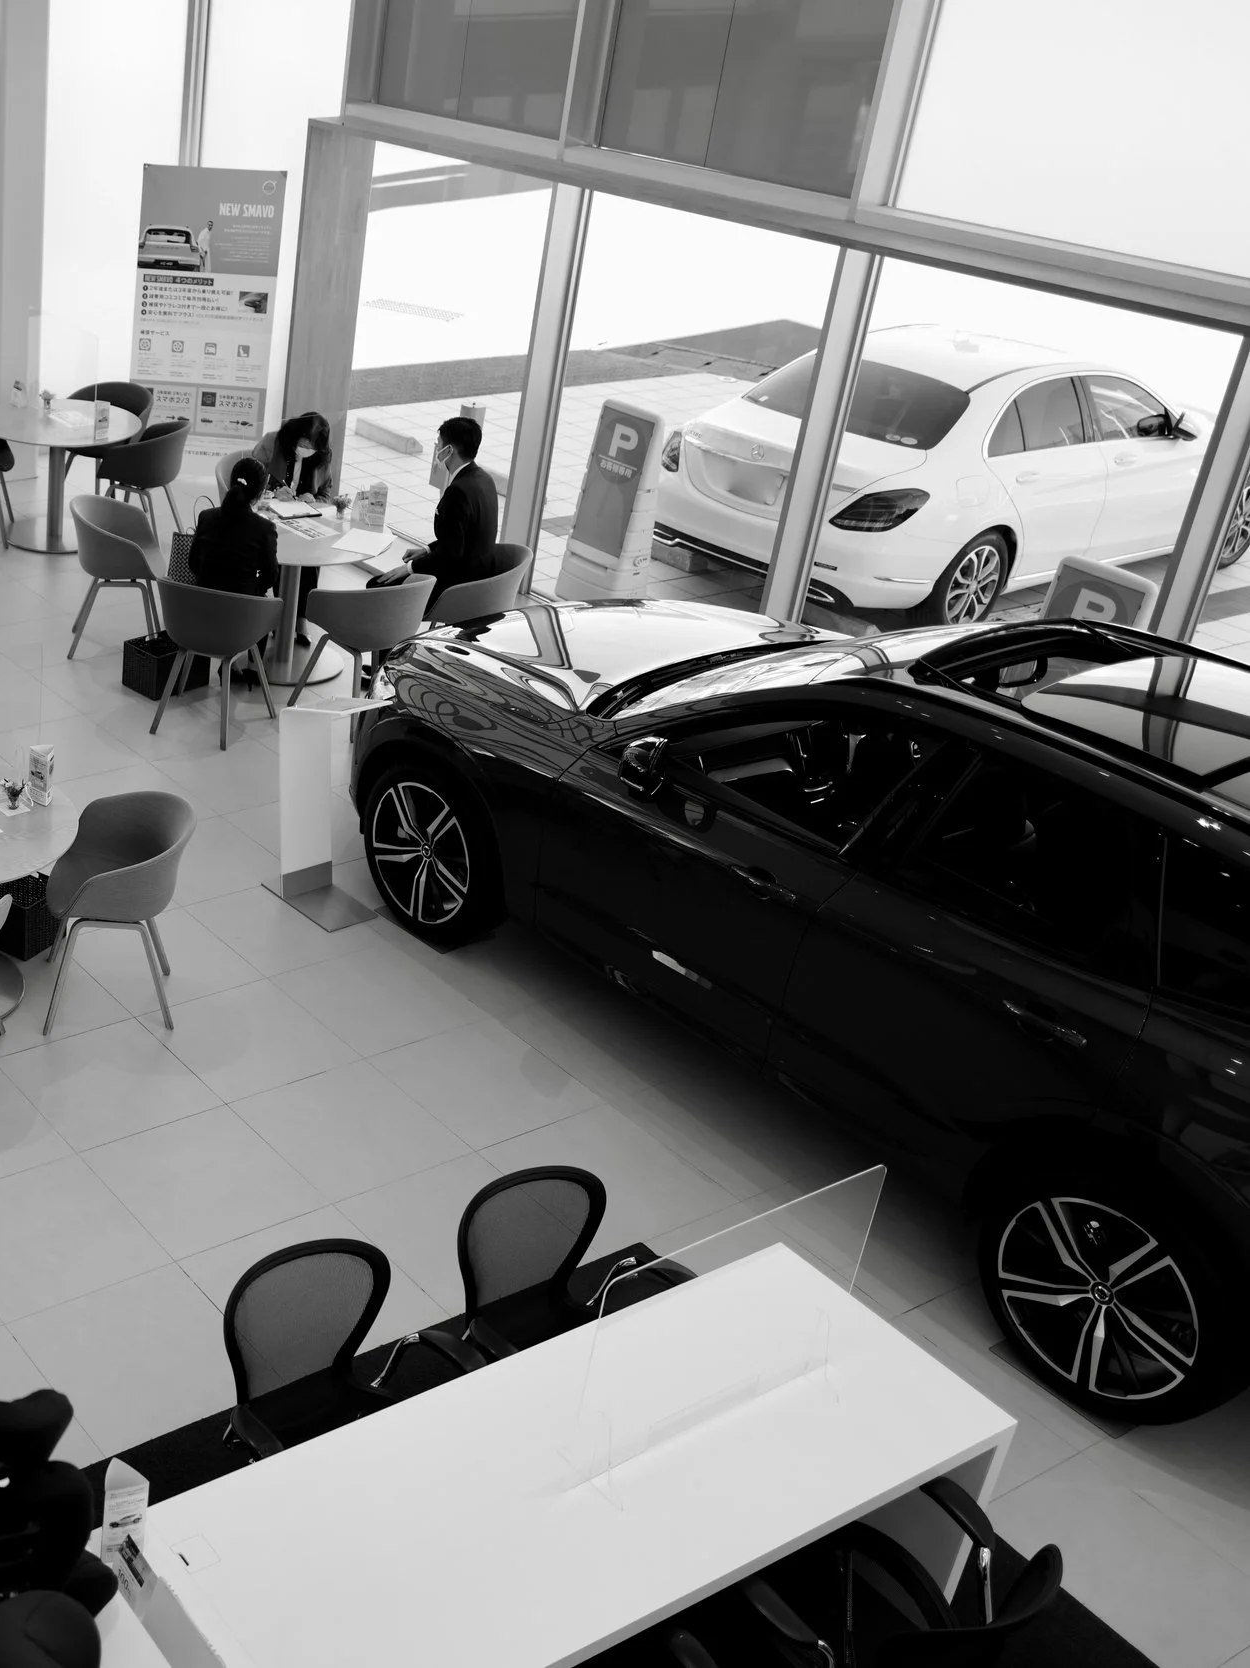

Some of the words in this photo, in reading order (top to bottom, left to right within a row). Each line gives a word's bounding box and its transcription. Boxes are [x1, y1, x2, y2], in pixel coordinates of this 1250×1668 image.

[219, 203, 241, 216] NEW
[242, 204, 275, 218] SMAVO
[608, 423, 638, 458] P
[600, 459, 632, 478] お客様専用
[1070, 587, 1117, 623] P
